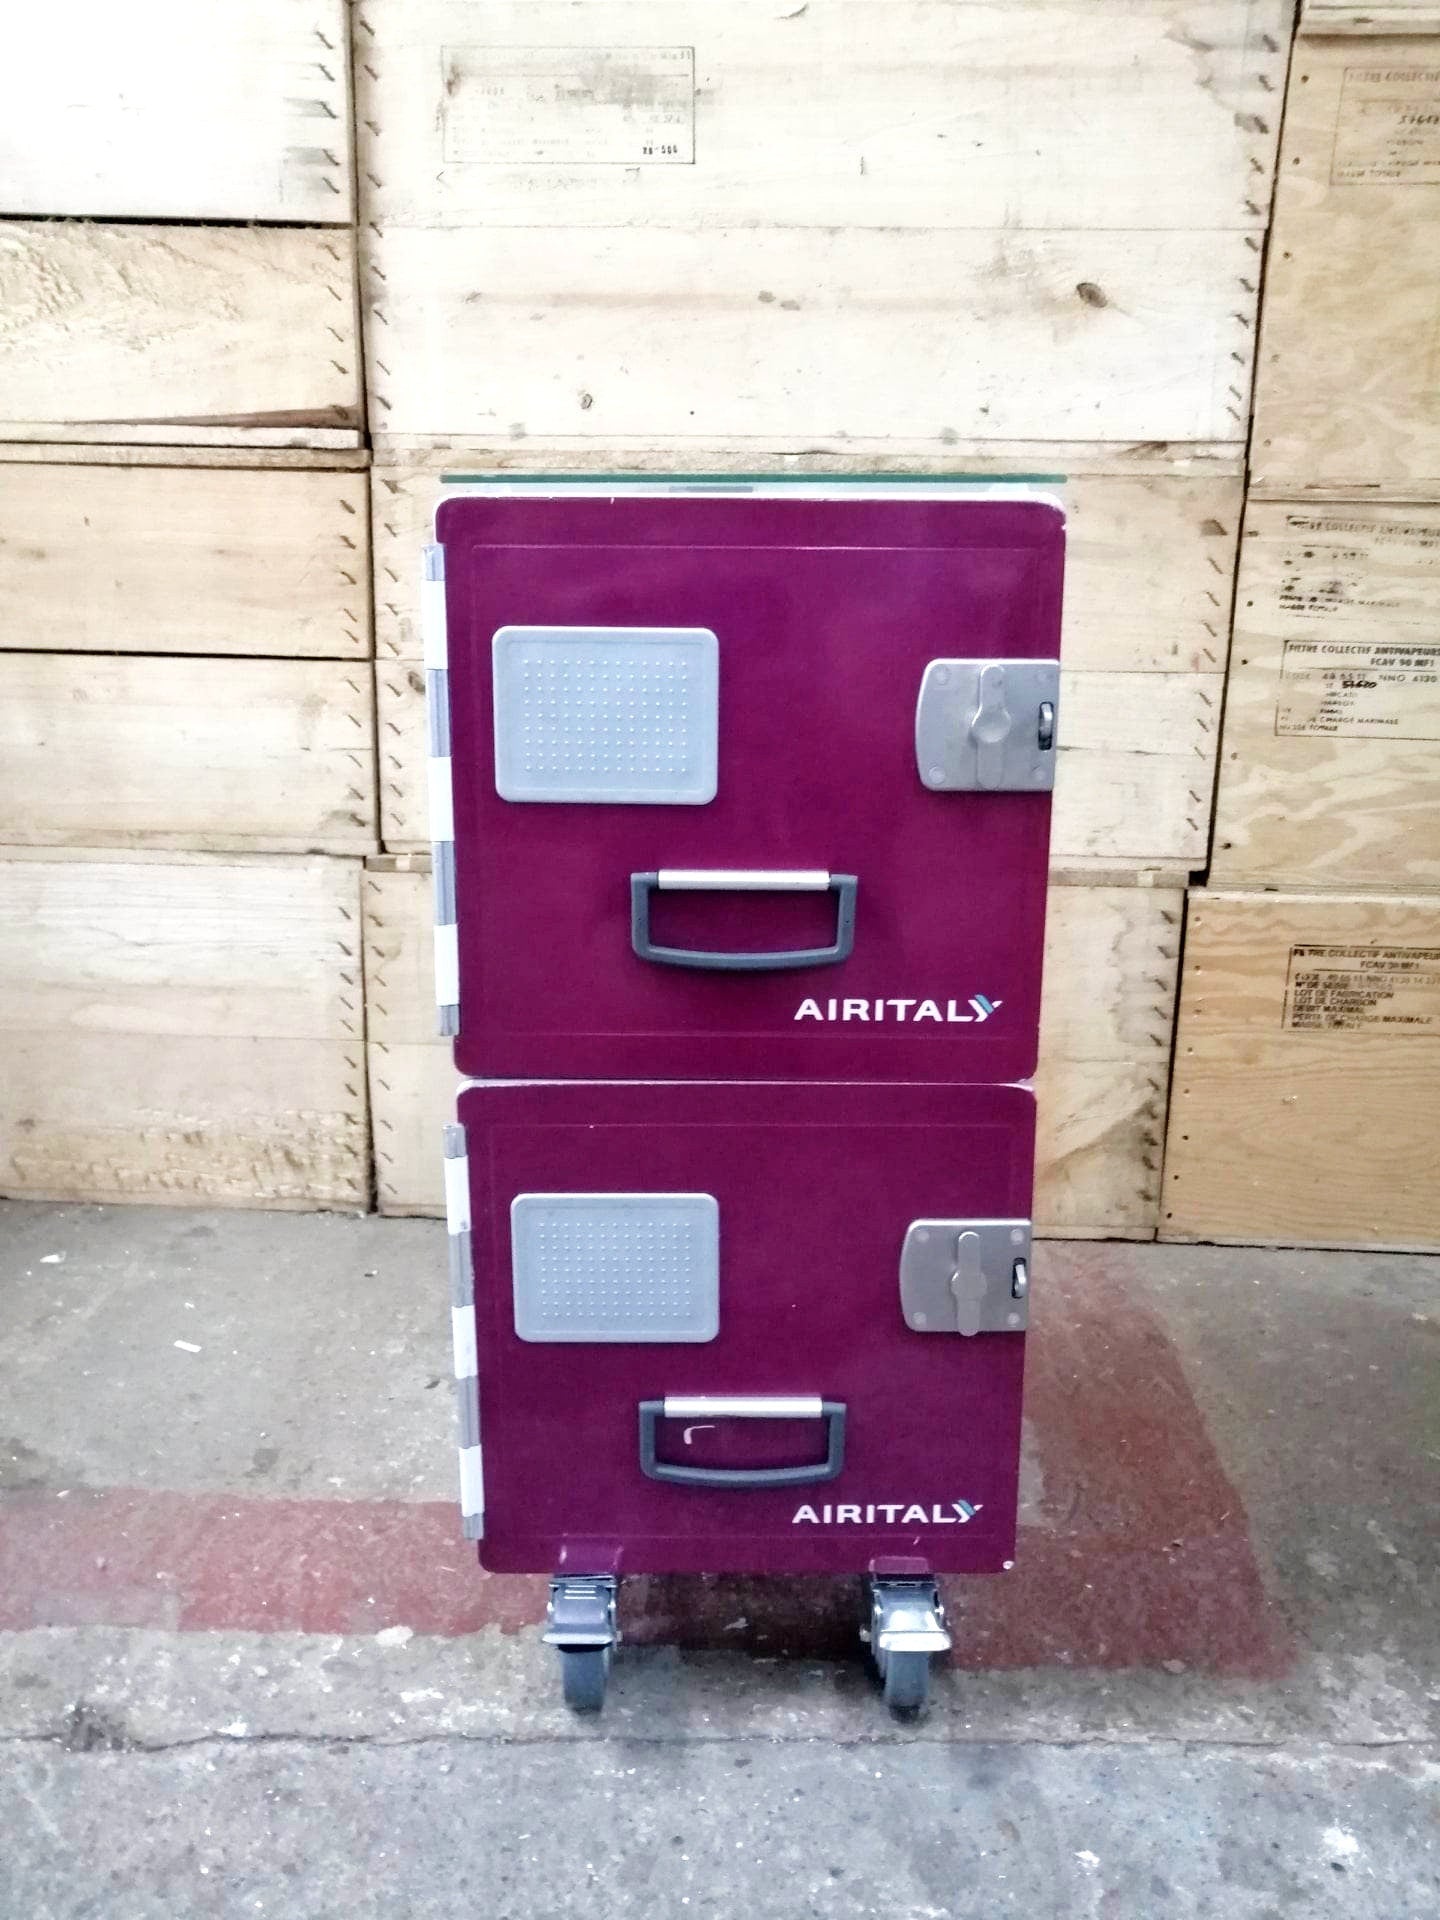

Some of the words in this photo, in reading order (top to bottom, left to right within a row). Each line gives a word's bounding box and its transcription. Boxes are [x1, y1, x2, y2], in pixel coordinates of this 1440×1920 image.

[1322, 646, 1371, 655] COLLECTIF
[1328, 950, 1380, 959] COLLECTIF
[1294, 989, 1312, 997] LOT
[1330, 991, 1394, 999] FABRICATION
[1330, 998, 1377, 1006] CHARBON
[793, 994, 1003, 1022] AIRITALY
[1382, 1016, 1433, 1025] MAXIMALE
[791, 1499, 984, 1523] AIRITALY
